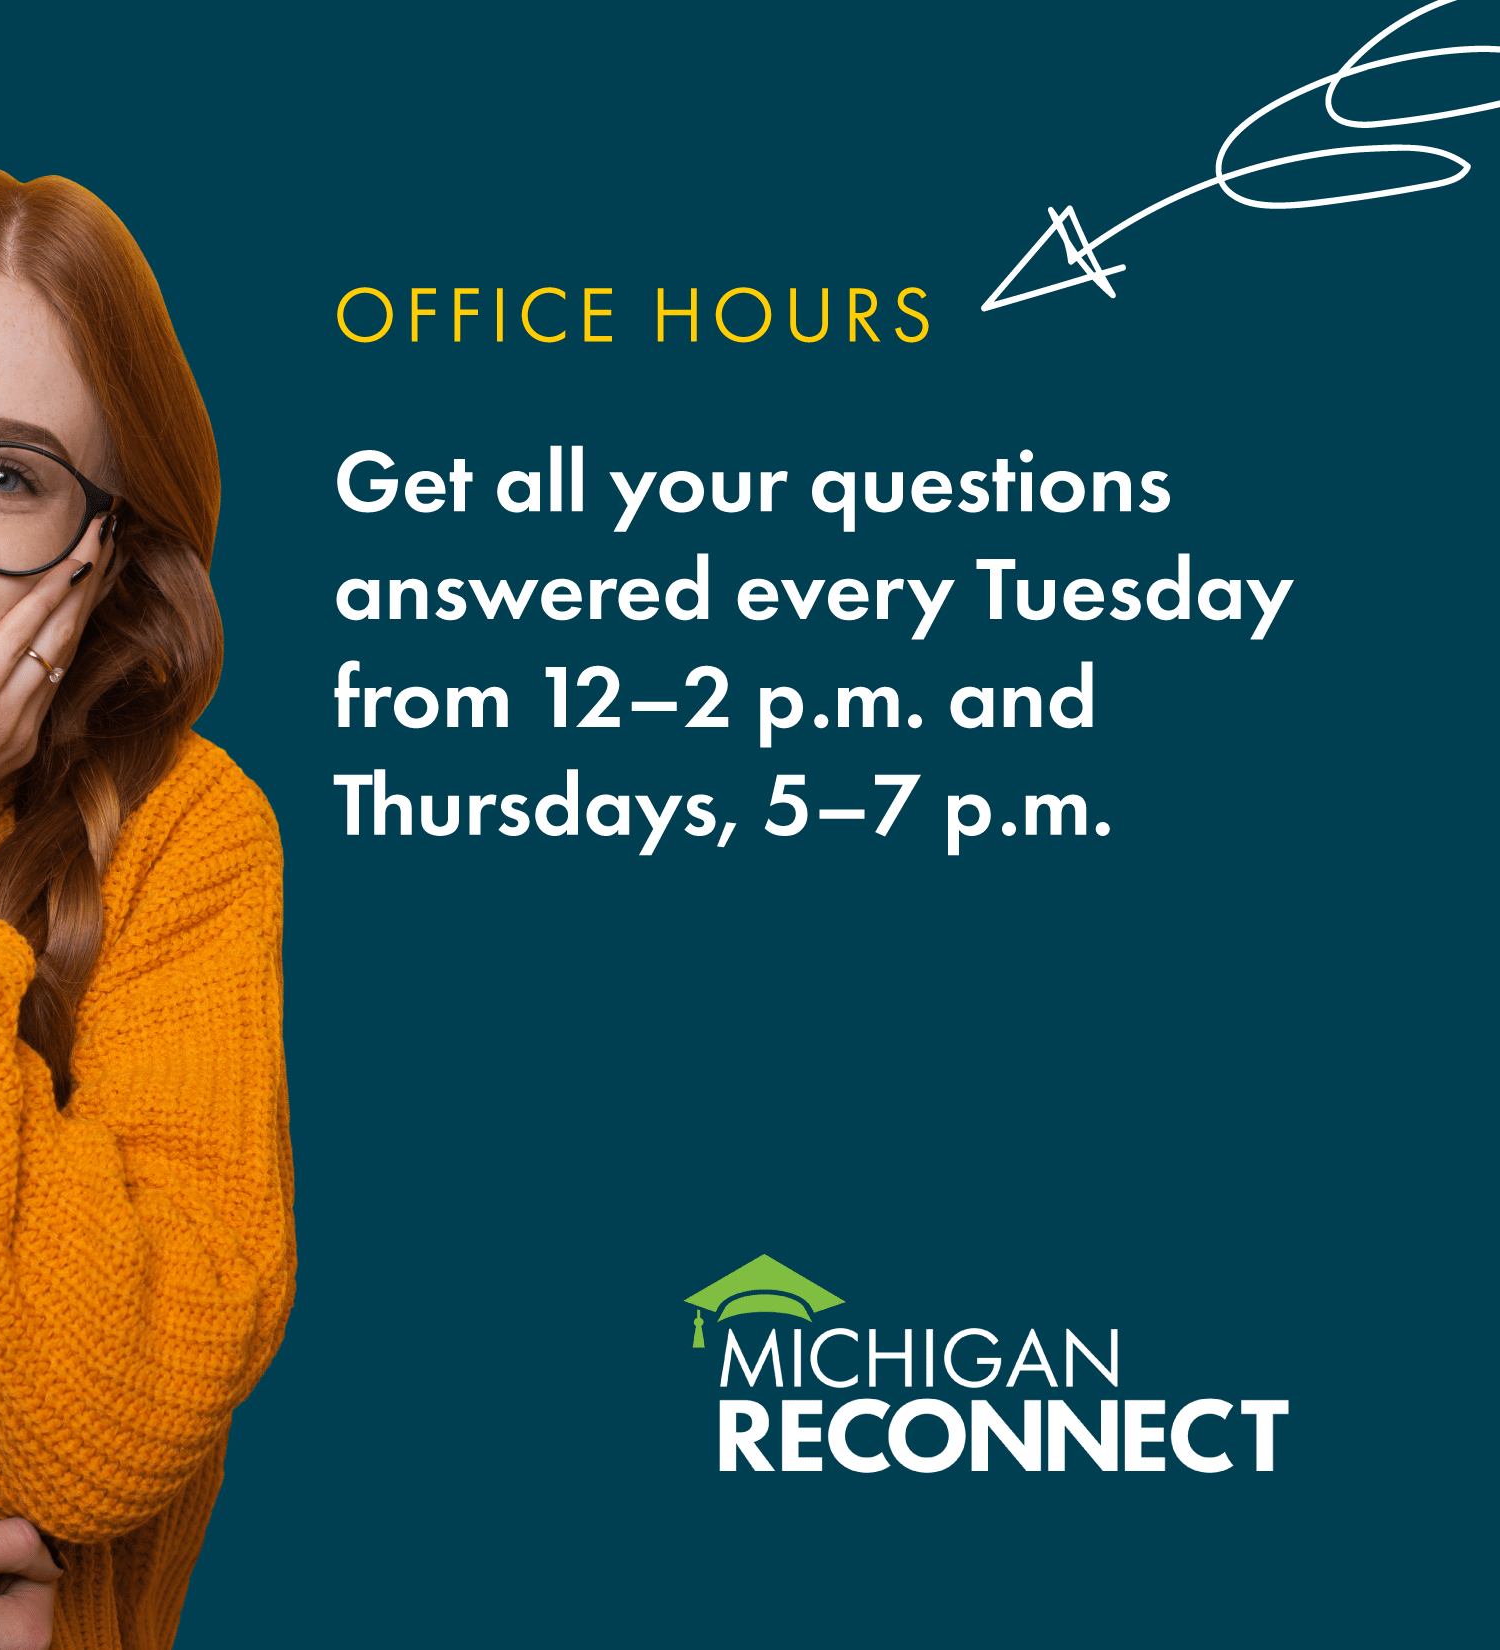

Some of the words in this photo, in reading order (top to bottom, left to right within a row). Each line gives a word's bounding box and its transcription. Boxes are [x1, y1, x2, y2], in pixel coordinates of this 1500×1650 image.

[337, 287, 612, 342] OFFICE
[658, 287, 928, 342] HOURS
[337, 450, 472, 512] Get
[497, 446, 583, 512] all
[610, 471, 788, 532] your
[812, 450, 1170, 532] questions
[337, 554, 708, 620] answered
[738, 579, 955, 639] every
[977, 554, 1294, 639] Tuesday
[335, 661, 508, 728] from
[760, 687, 922, 747] p.m.
[951, 662, 1092, 728] and
[334, 769, 736, 855] Thursdays,
[948, 795, 1110, 855] p.m.
[720, 1328, 1117, 1388] MICHIGAN
[720, 1399, 1288, 1473] RECONNECT
